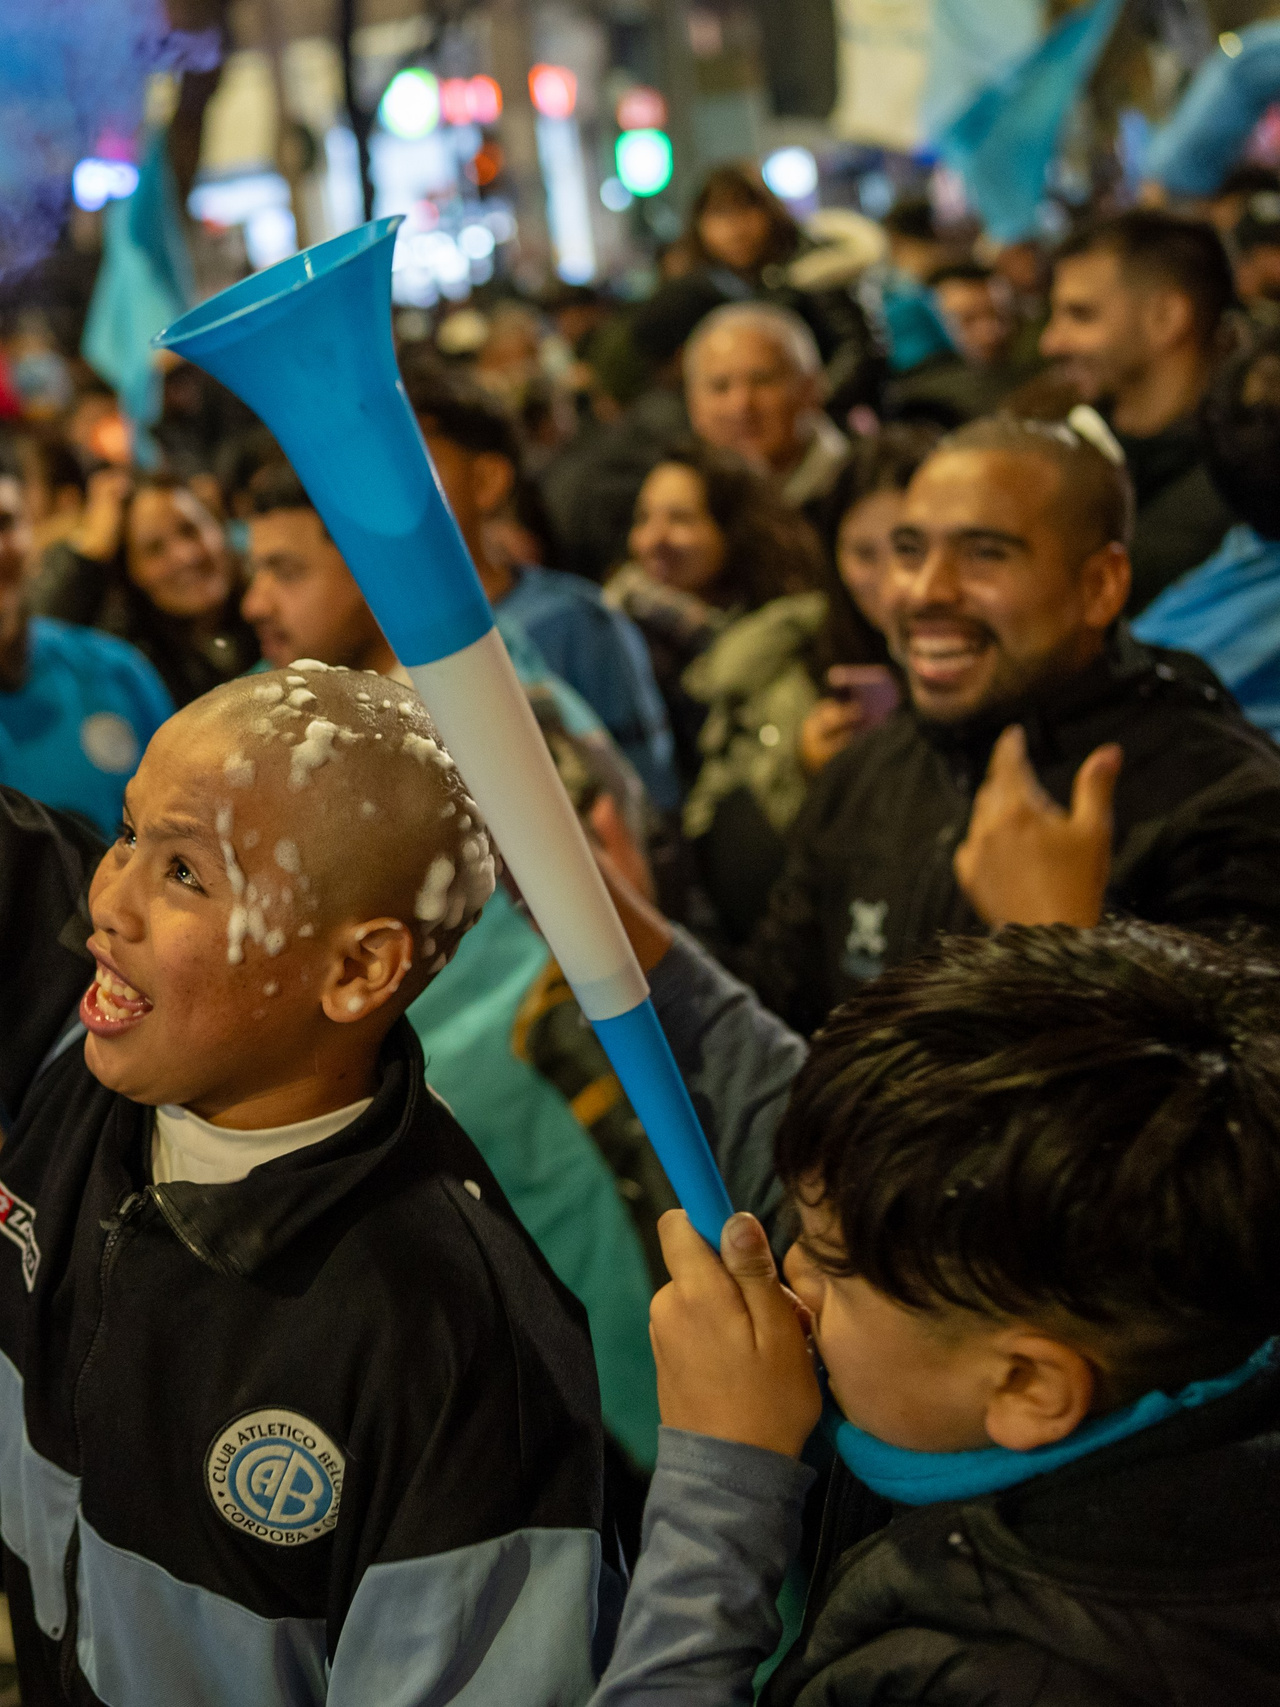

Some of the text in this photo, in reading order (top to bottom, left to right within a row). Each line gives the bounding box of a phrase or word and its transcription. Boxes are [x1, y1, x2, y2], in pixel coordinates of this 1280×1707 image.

[212, 1442, 237, 1484] CLUB
[237, 1422, 317, 1450] ATLETICO
[222, 1503, 309, 1544] CORDOBA
